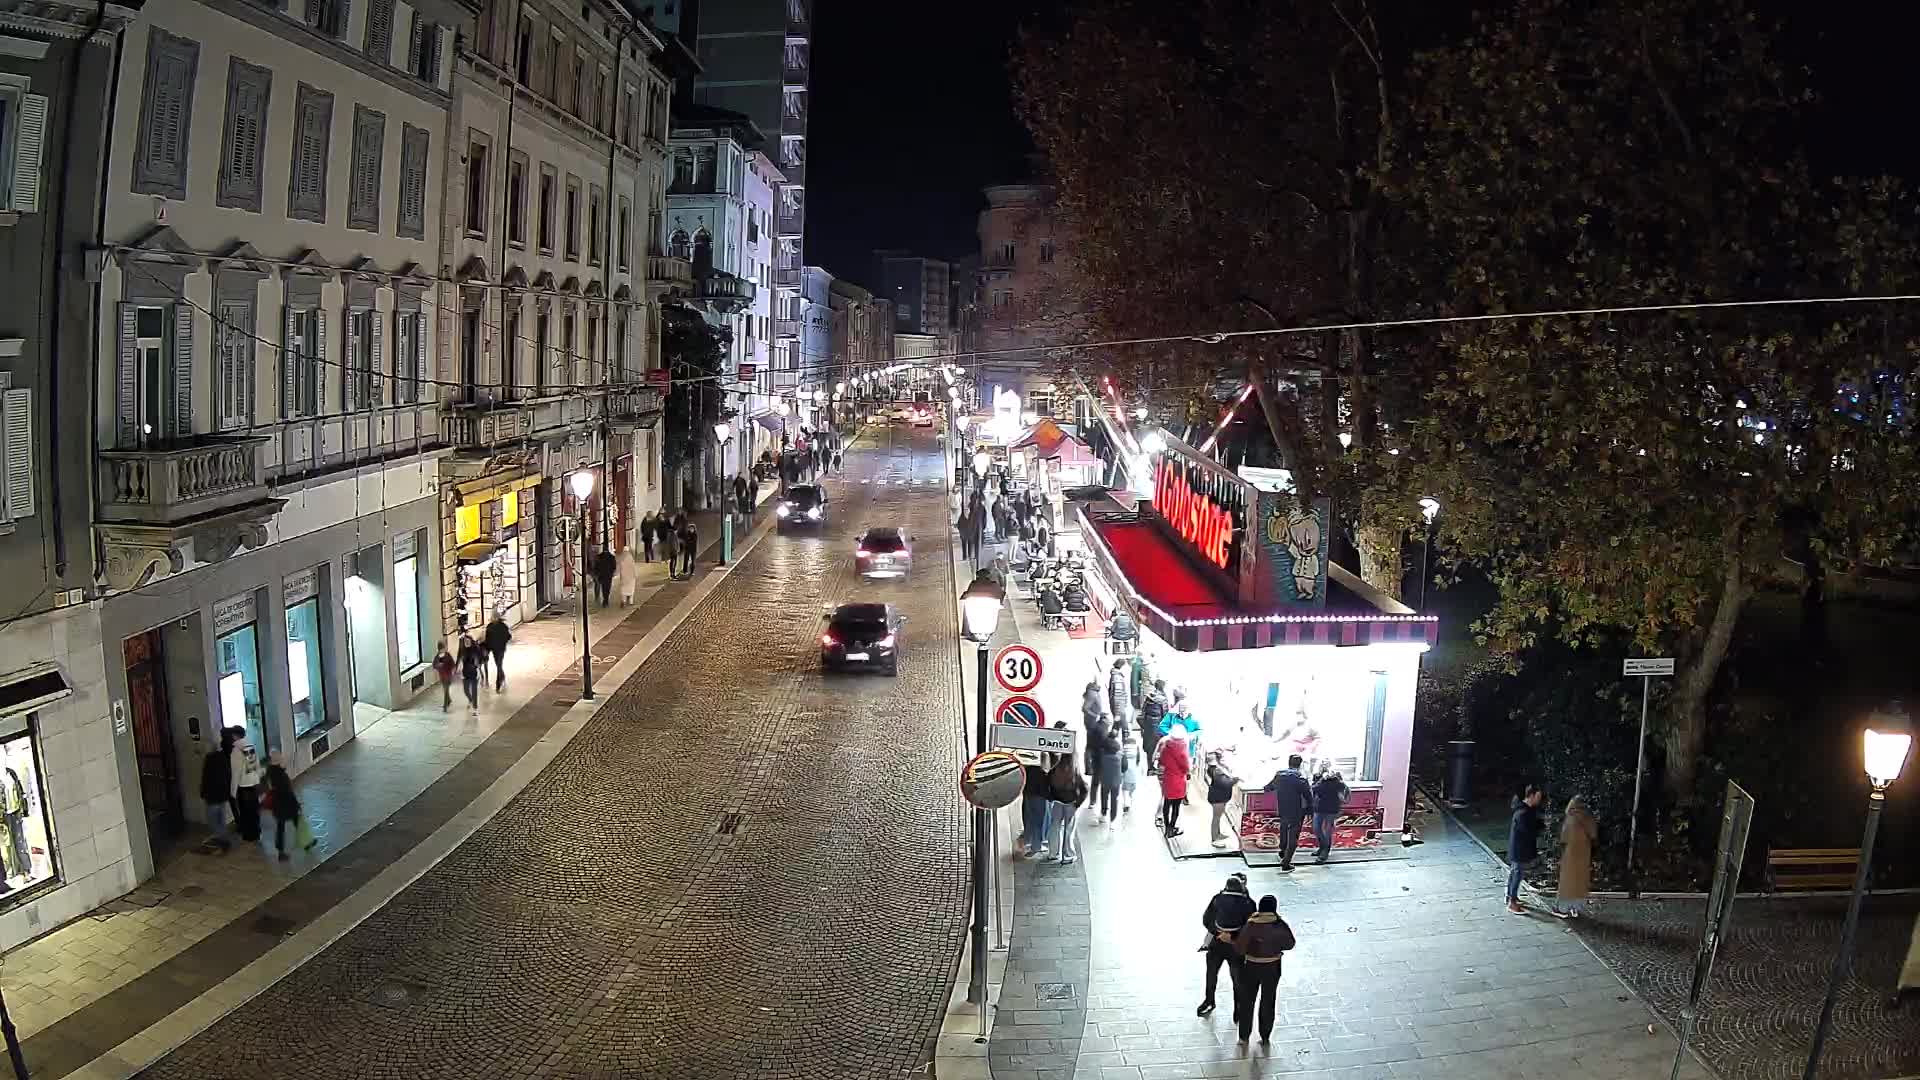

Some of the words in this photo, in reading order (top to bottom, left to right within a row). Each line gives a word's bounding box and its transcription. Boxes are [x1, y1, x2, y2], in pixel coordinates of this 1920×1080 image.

[1162, 455, 1233, 569] Golosone
[1006, 658, 1032, 680] 30
[1038, 737, 1070, 749] Dante
